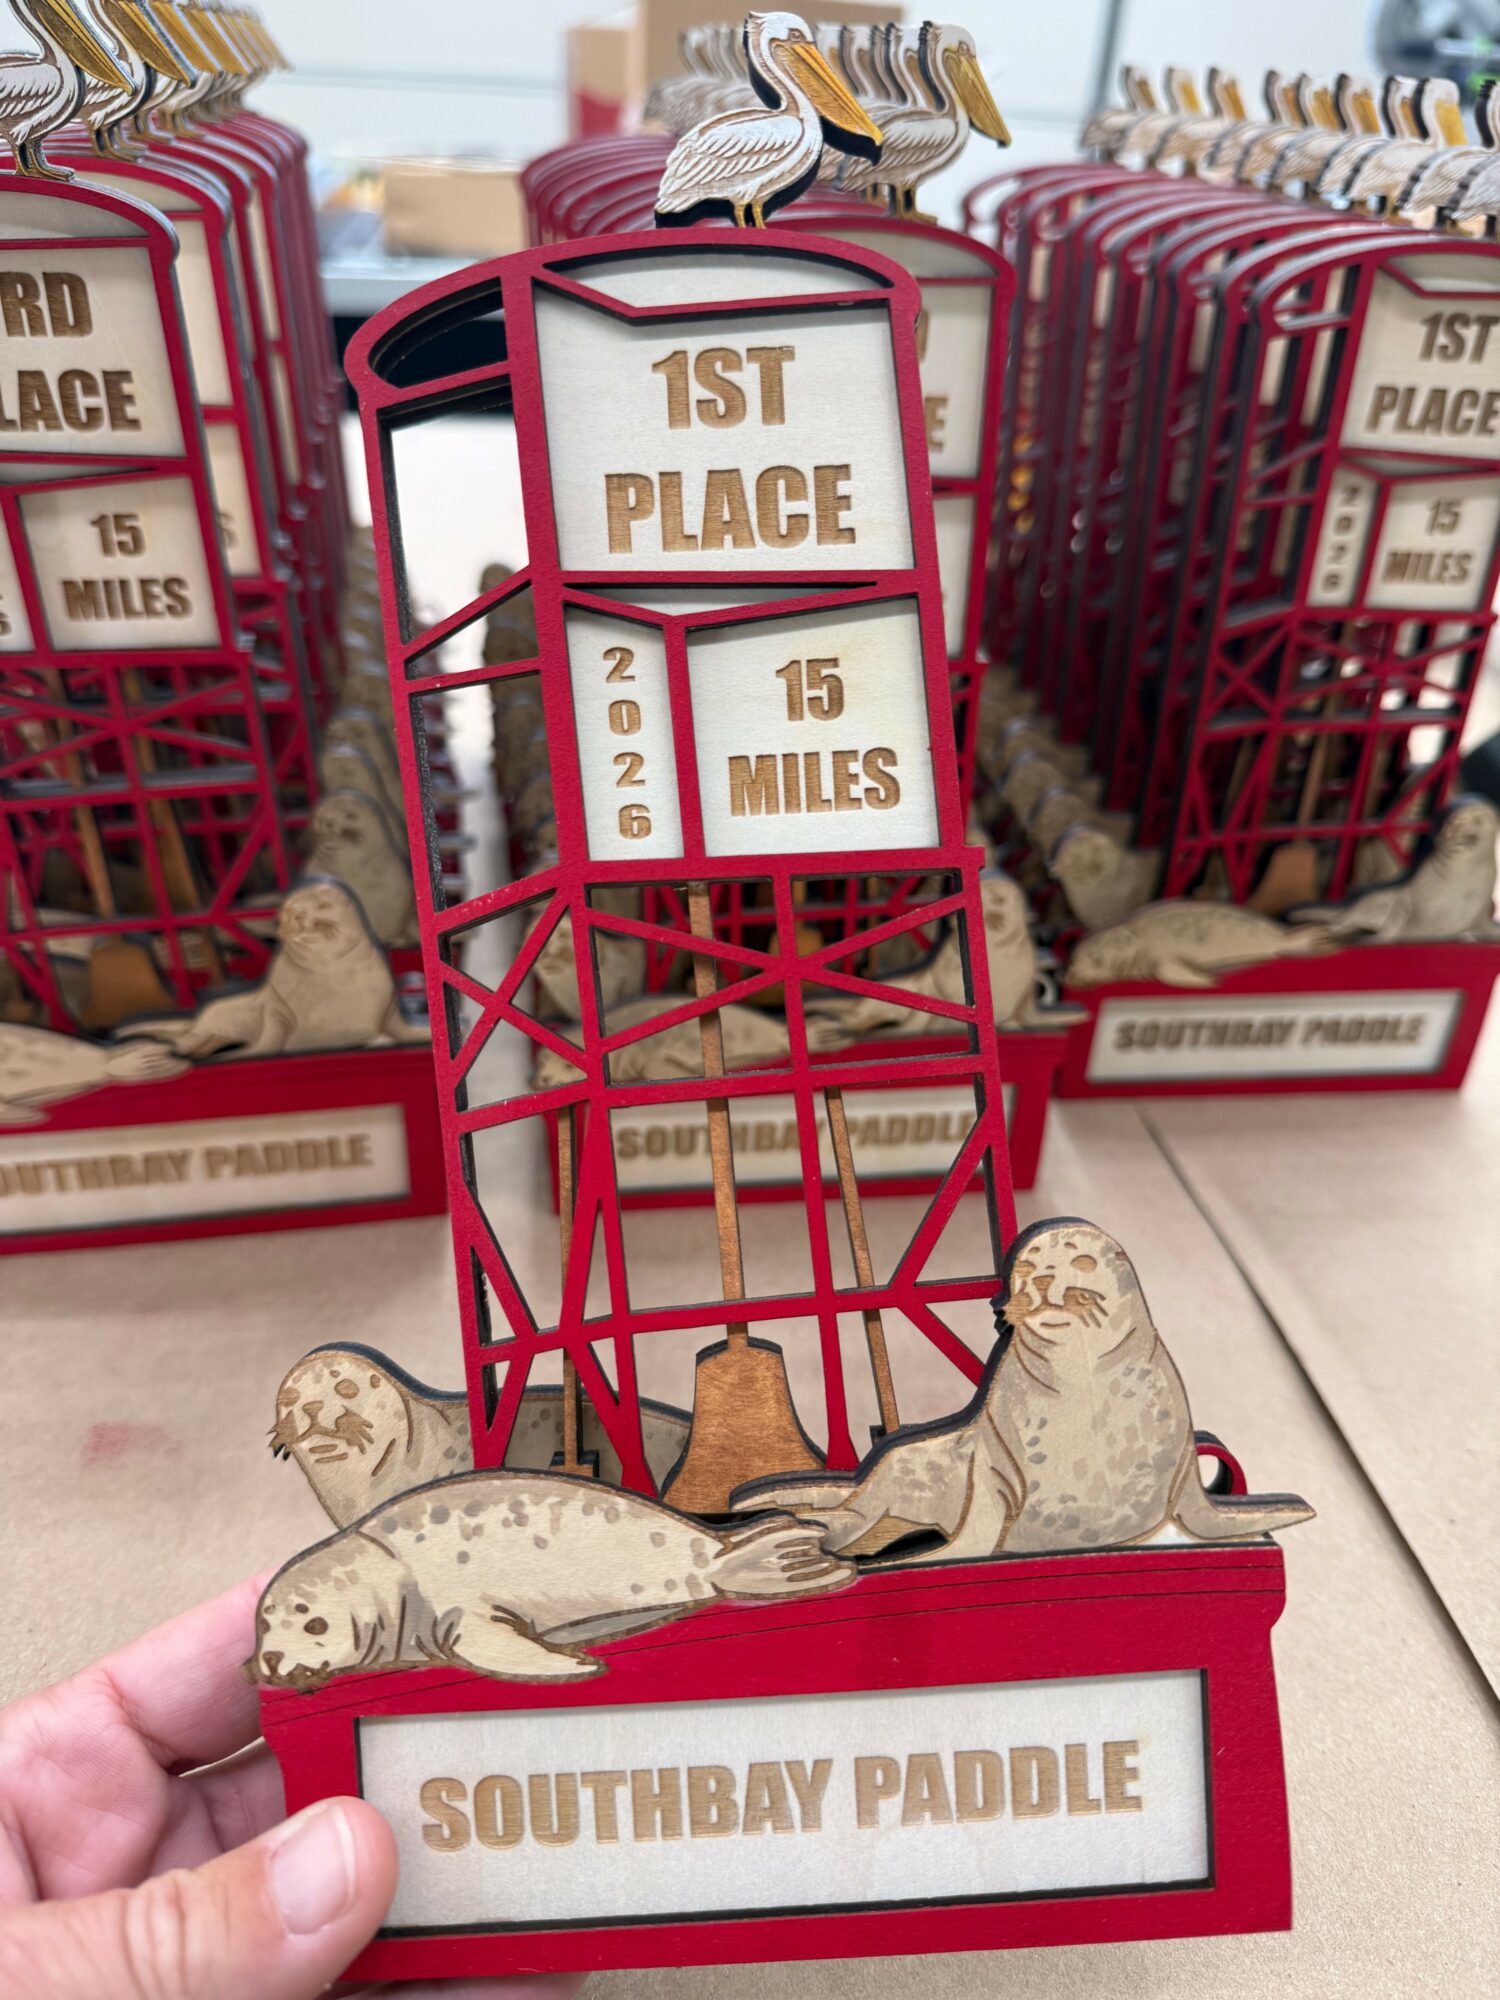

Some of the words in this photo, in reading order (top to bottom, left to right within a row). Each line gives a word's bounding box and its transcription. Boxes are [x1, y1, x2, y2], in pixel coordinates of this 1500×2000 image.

[1419, 313, 1500, 364] 1ST
[651, 345, 796, 430] 1ST
[1365, 387, 1500, 435] PLACE
[604, 464, 857, 554] PLACE
[1425, 499, 1462, 537] 15
[90, 512, 146, 557] 15
[1384, 552, 1471, 584] MILES
[61, 576, 194, 620] MILES
[775, 657, 845, 722] 15
[727, 747, 902, 818] MILES
[1113, 1018, 1297, 1052] SOUTHBAY
[1302, 1013, 1425, 1046] PADDLE
[205, 1134, 374, 1179] PADDLE
[419, 1759, 833, 1852] SOUTHBAY
[855, 1740, 1144, 1830] PADDLE
